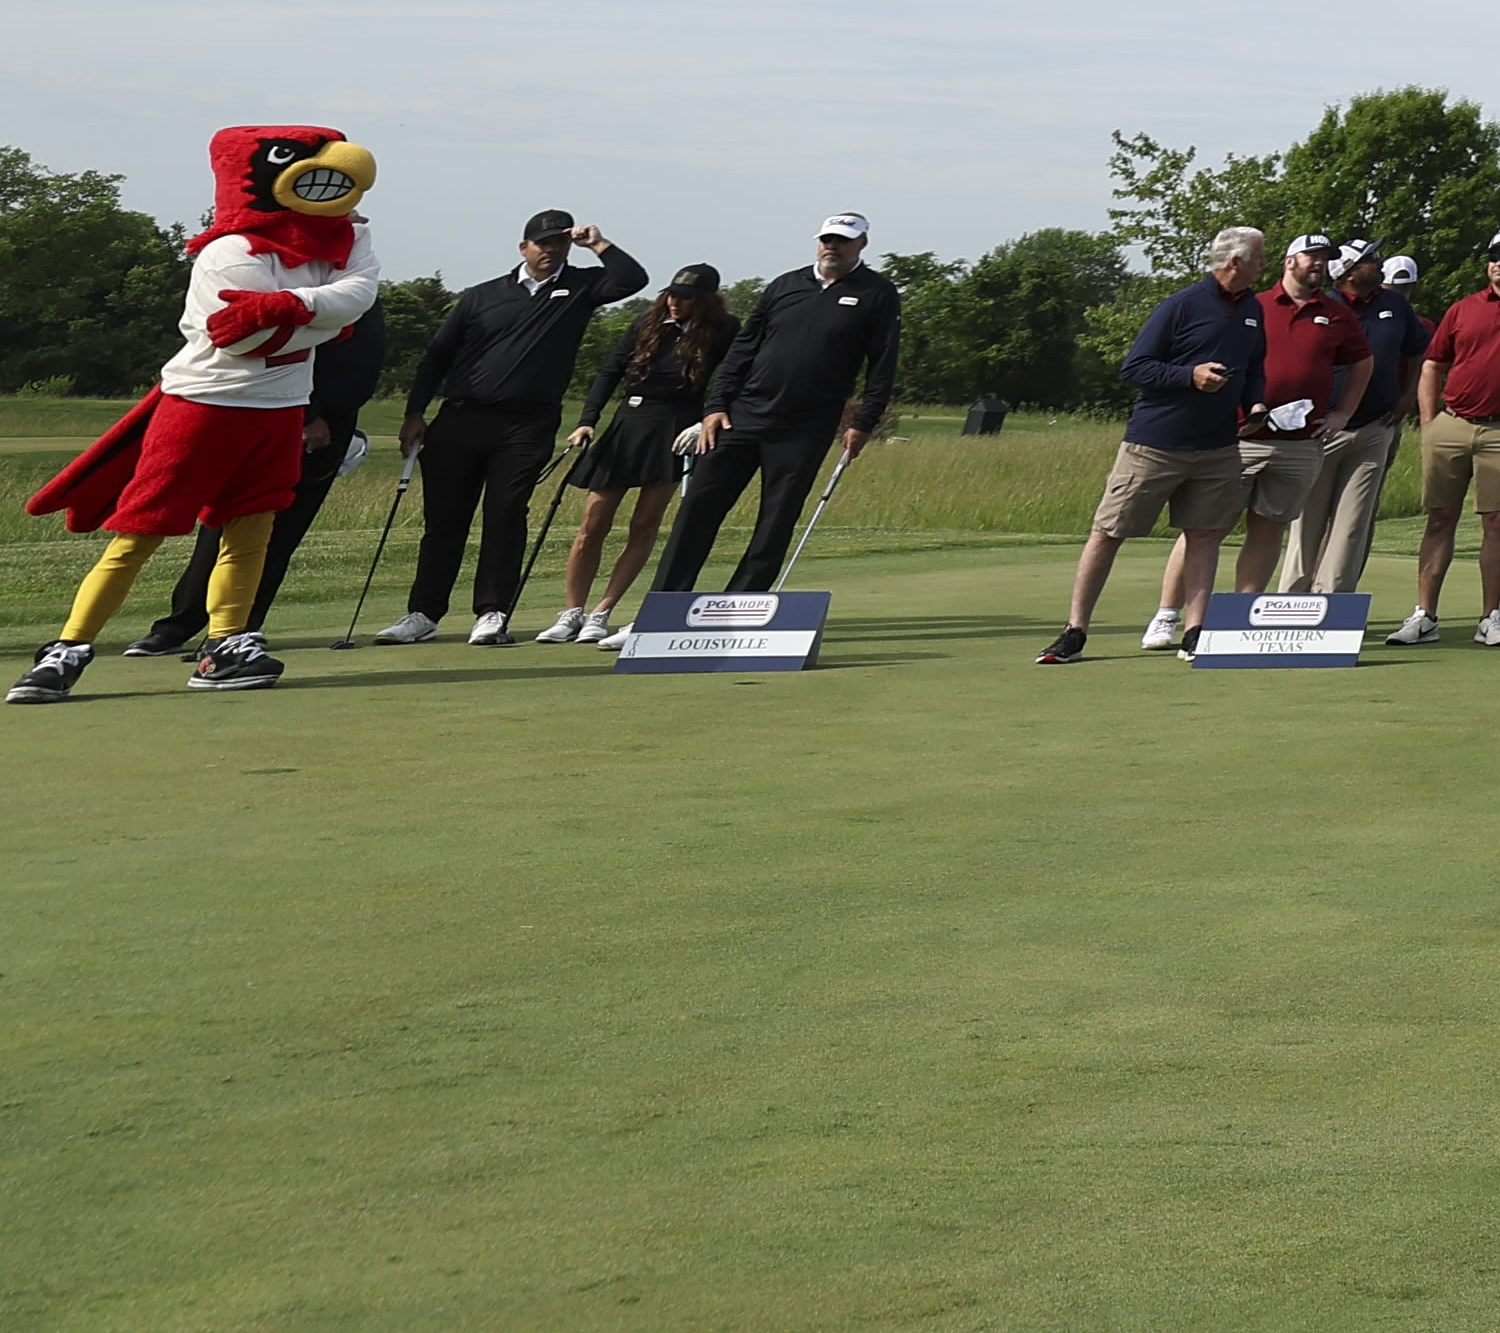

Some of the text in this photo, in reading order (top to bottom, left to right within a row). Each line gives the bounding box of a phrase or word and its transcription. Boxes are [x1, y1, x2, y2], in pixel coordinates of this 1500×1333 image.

[705, 600, 773, 609] PGA HOPE
[1264, 601, 1323, 609] PGA HOPE
[1240, 631, 1327, 641] NORTHERN
[667, 638, 768, 650] LOUISVILLE
[1257, 642, 1303, 652] TEXAS
